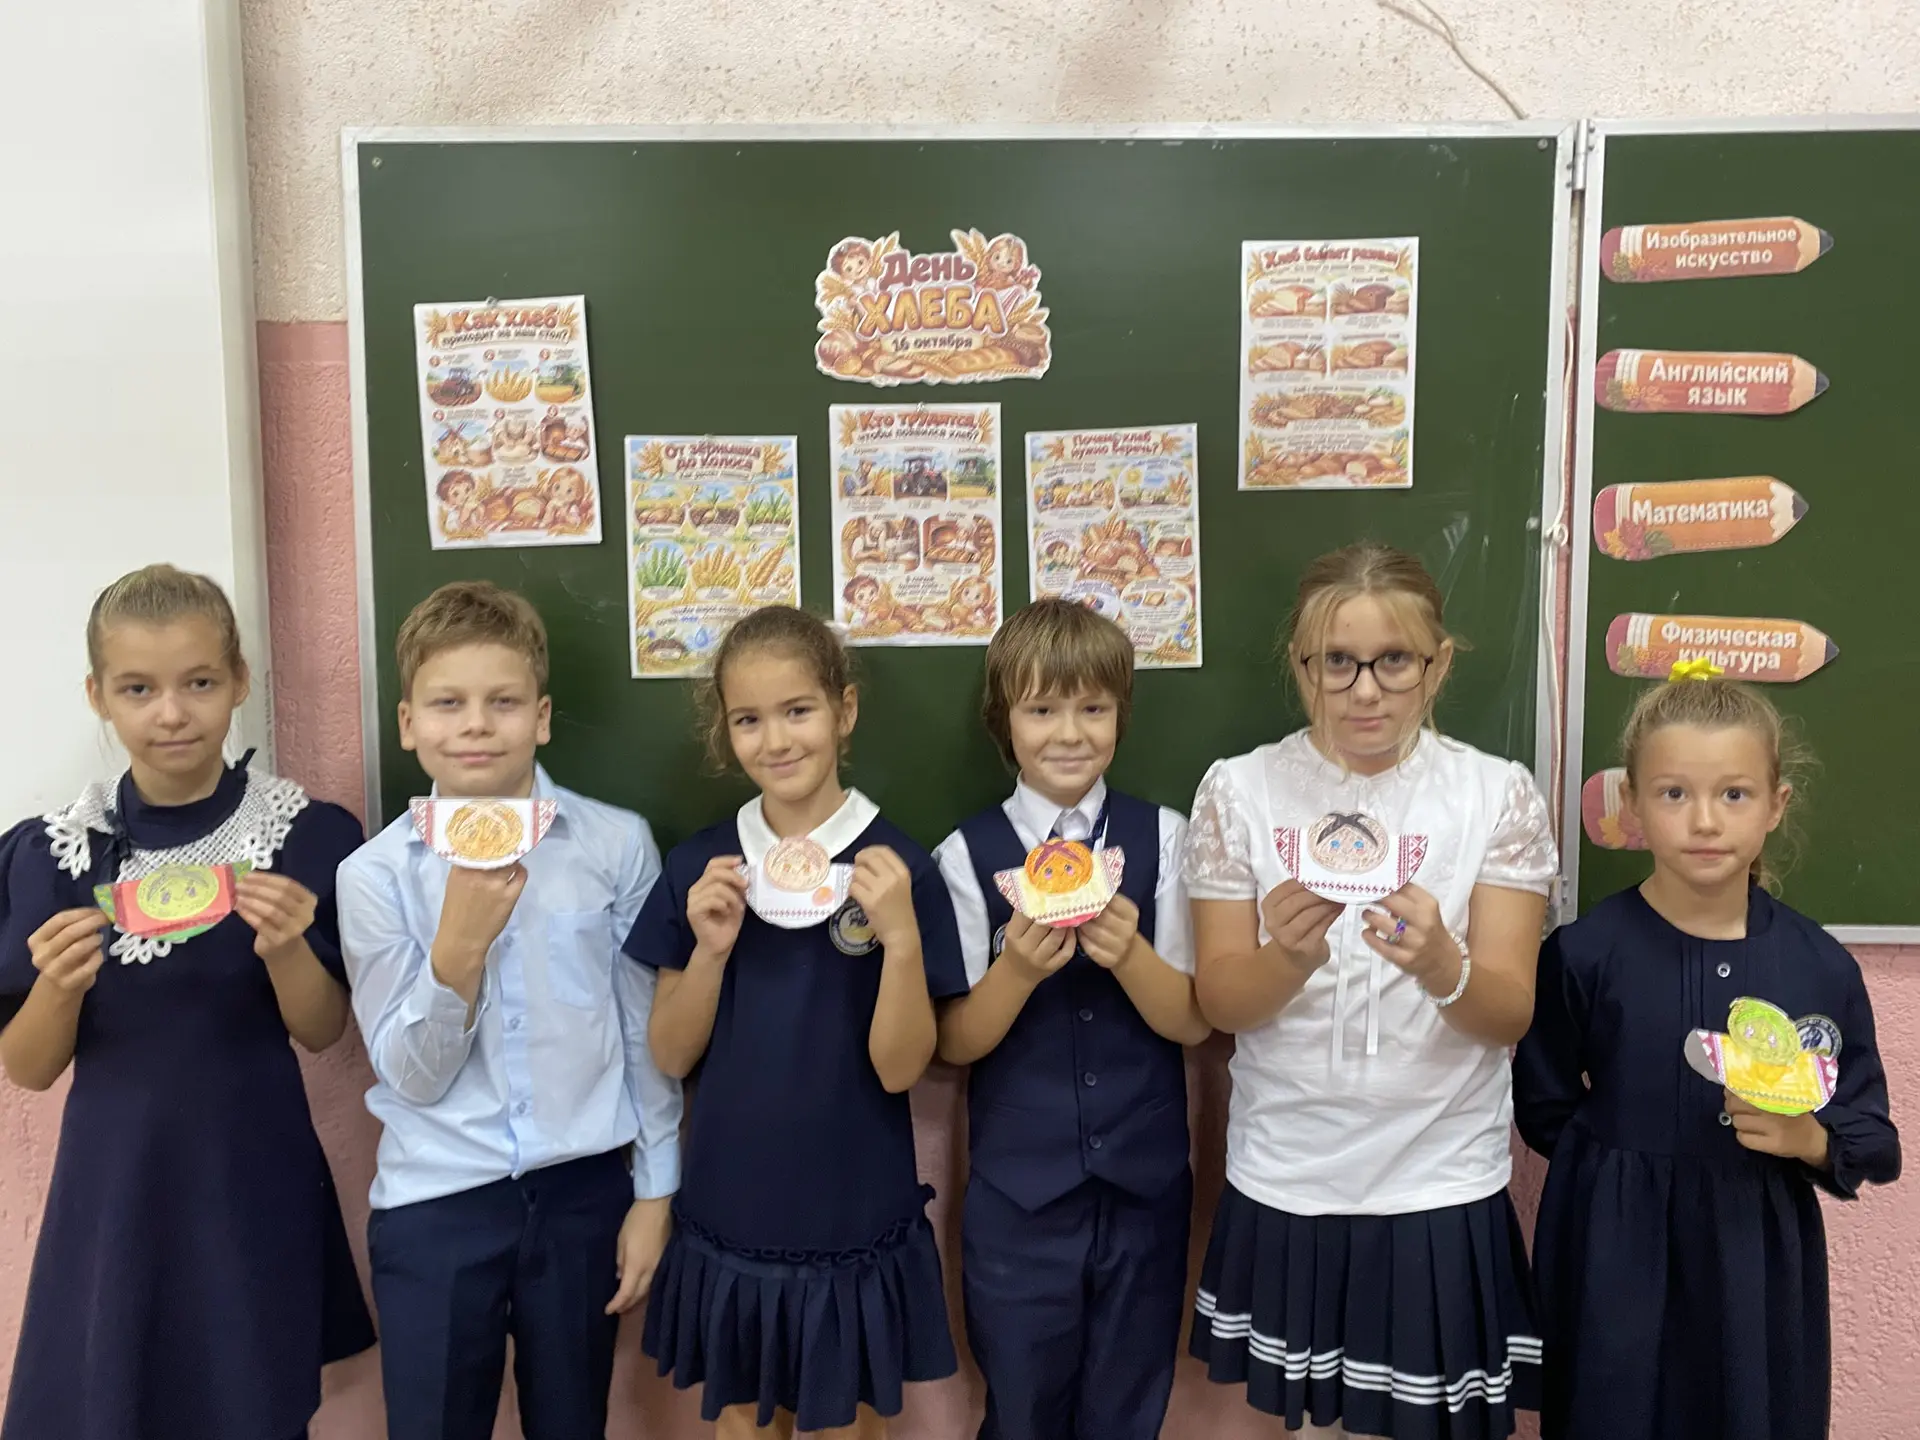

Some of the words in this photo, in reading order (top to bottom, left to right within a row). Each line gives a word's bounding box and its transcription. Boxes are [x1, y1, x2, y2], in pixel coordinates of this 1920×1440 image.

[1646, 228, 1797, 250] Изобразительное
[879, 252, 977, 290] День
[1676, 249, 1773, 271] искусство
[451, 307, 499, 333] Как
[504, 303, 558, 329] хлеб
[857, 286, 1005, 337] ХЛЕБА
[892, 338, 909, 351] 16
[913, 335, 973, 349] октября
[1649, 358, 1789, 385] Английский
[1687, 388, 1748, 406] язык
[858, 410, 894, 431] Кто
[1632, 499, 1770, 525] Математика
[1661, 621, 1797, 648] Физическая
